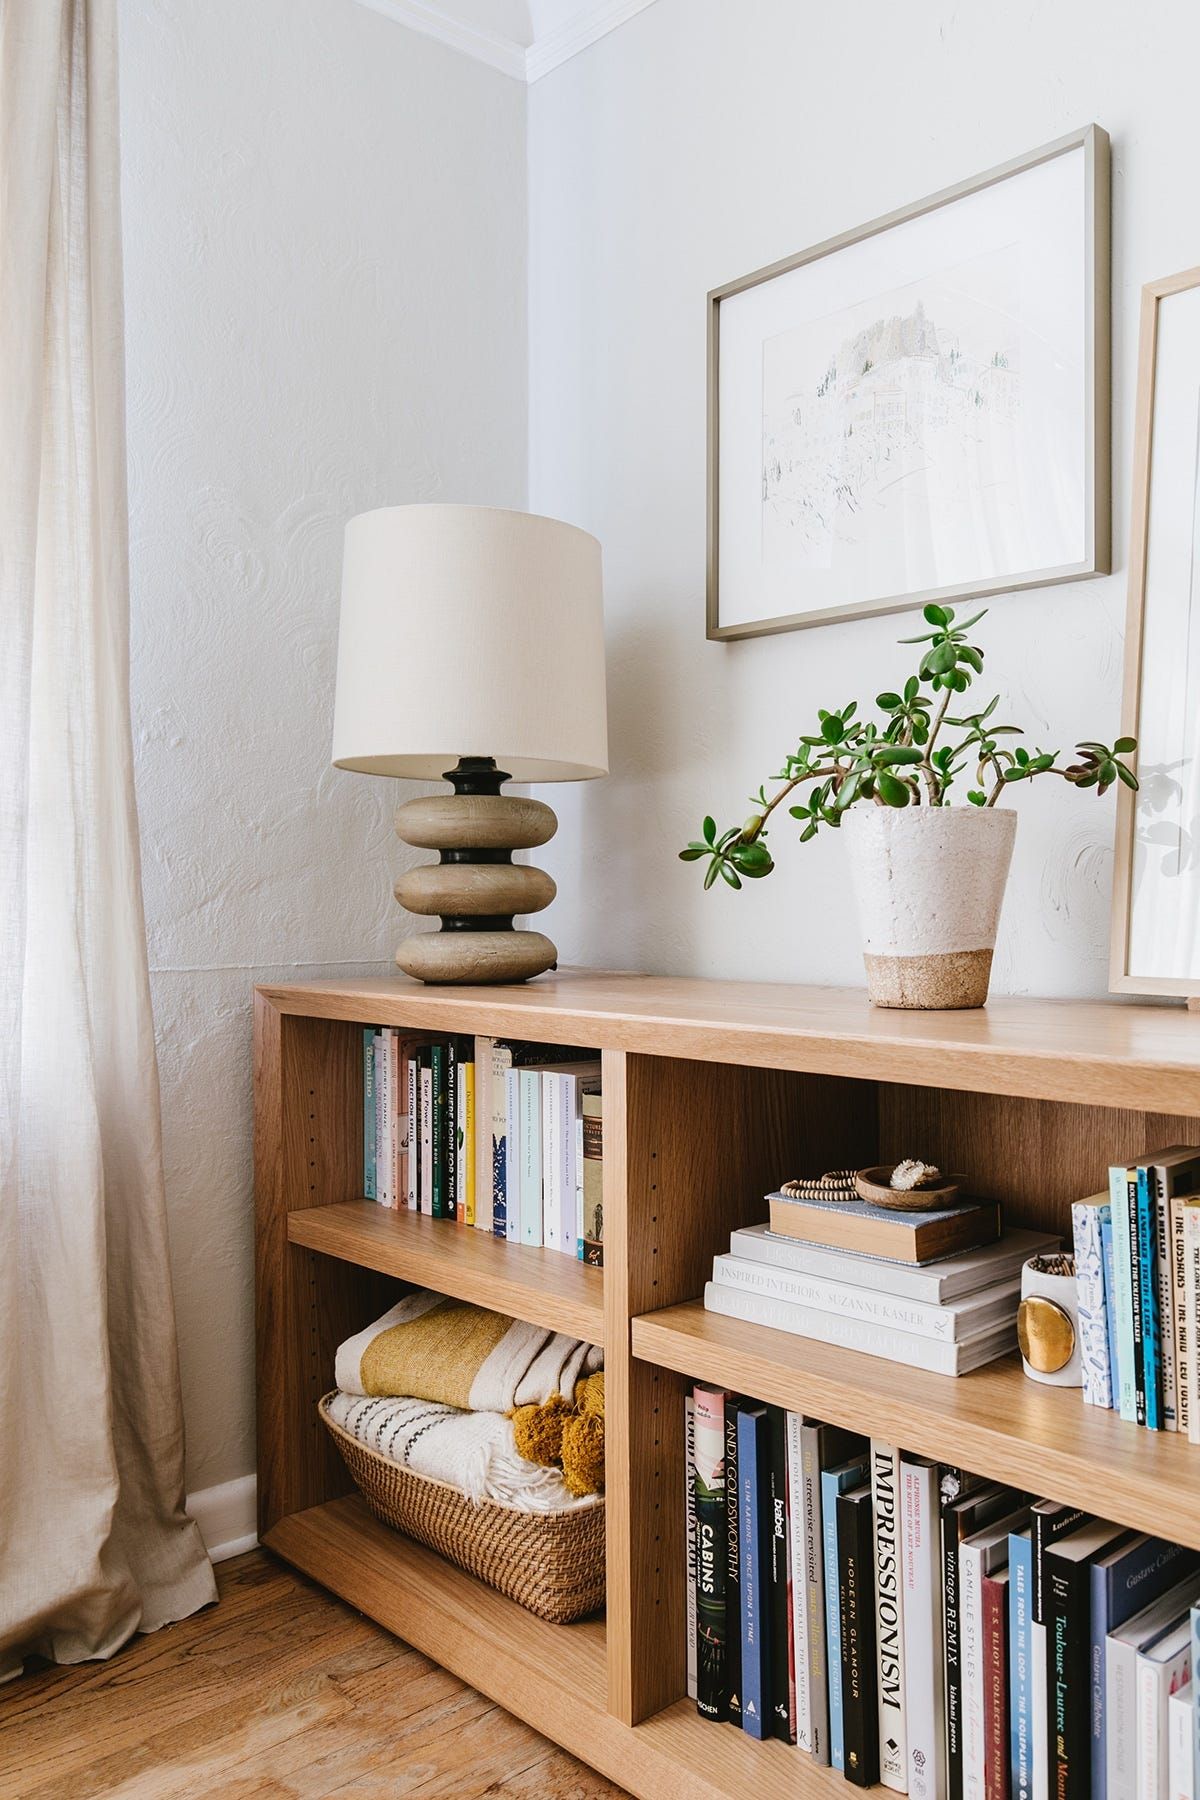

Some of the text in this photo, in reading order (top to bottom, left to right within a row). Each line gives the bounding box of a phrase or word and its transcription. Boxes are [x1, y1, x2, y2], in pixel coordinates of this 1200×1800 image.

[366, 1046, 374, 1098] domino
[1130, 1223, 1138, 1255] REVERIES
[1159, 1220, 1167, 1260] HUXLEY
[721, 1266, 764, 1286] INSPIRED
[767, 1278, 821, 1300] INTERIORS
[828, 1293, 878, 1315] SUZANNE
[882, 1305, 924, 1325] KASLER
[1088, 1281, 1098, 1311] French
[1132, 1281, 1140, 1313] SOLITARY
[726, 1420, 739, 1583] ANDY GOLDSWORTHY
[744, 1479, 752, 1503] SLIM
[794, 1509, 800, 1522] OF
[774, 1498, 784, 1539] babel
[827, 1521, 835, 1545] THE
[907, 1519, 914, 1530] OF
[688, 1539, 696, 1584] LOVE
[701, 1524, 714, 1593] CABINS
[804, 1451, 821, 1678] tiny streetwise revisited mary ellen mark
[828, 1547, 838, 1601] INSPIRED
[874, 1450, 902, 1712] IMPRESSIONISM
[945, 1550, 956, 1604] vintage
[1126, 1561, 1156, 1590] Gustave
[965, 1559, 974, 1619] CAMILLE
[830, 1605, 838, 1637] ROOM
[848, 1557, 859, 1699] MODERN GLAMOUR
[947, 1607, 957, 1667] REMIX
[967, 1625, 976, 1680] STYLES
[1017, 1564, 1028, 1787] TALES FROM THE LOOP THE ROLEPLAYING
[1055, 1615, 1068, 1733] Toulouse-Lautrec
[697, 1700, 719, 1714] ASCHEN
[992, 1631, 1002, 1790] ELIOT COLLECTED POEMS
[1093, 1644, 1103, 1739] Gustave Caillebotte
[1115, 1664, 1126, 1734] RESTORATION
[949, 1721, 958, 1754] perera
[1056, 1735, 1068, 1760] and
